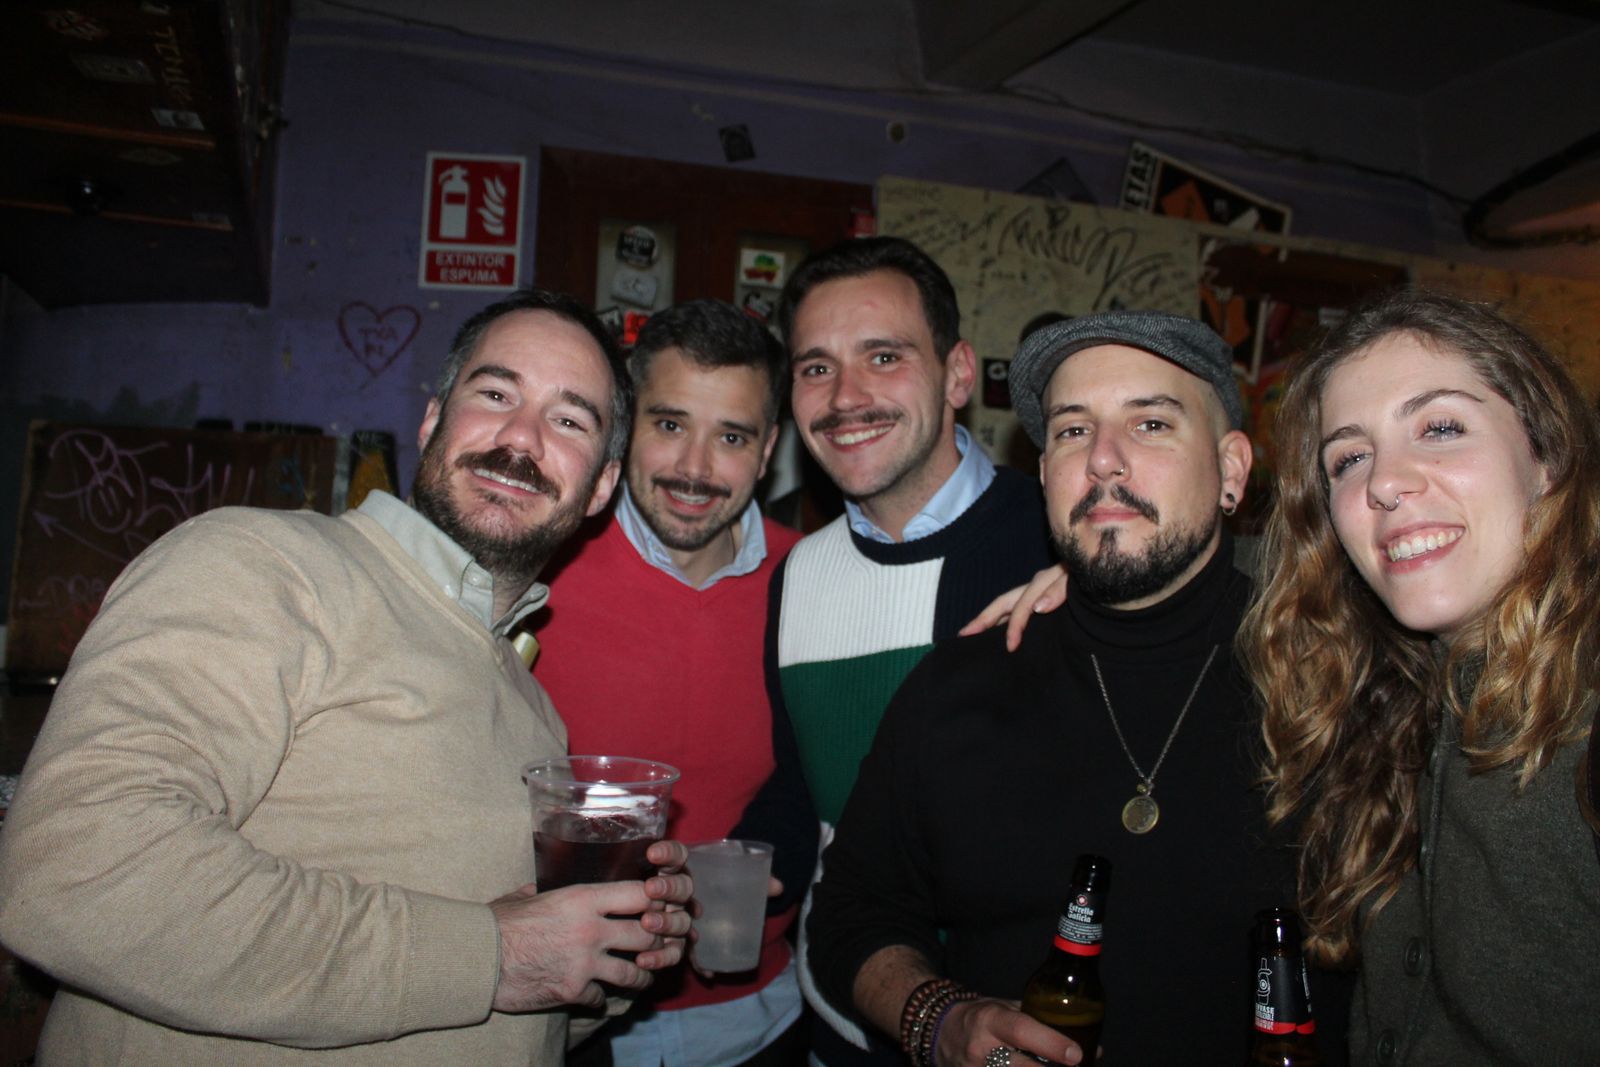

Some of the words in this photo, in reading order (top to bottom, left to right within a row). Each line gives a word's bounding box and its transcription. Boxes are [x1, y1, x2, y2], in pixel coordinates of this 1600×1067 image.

[435, 252, 507, 268] EXTINTOR
[439, 267, 499, 283] ESPUMA
[1067, 910, 1092, 923] Galicia
[1068, 902, 1094, 917] Estrella
